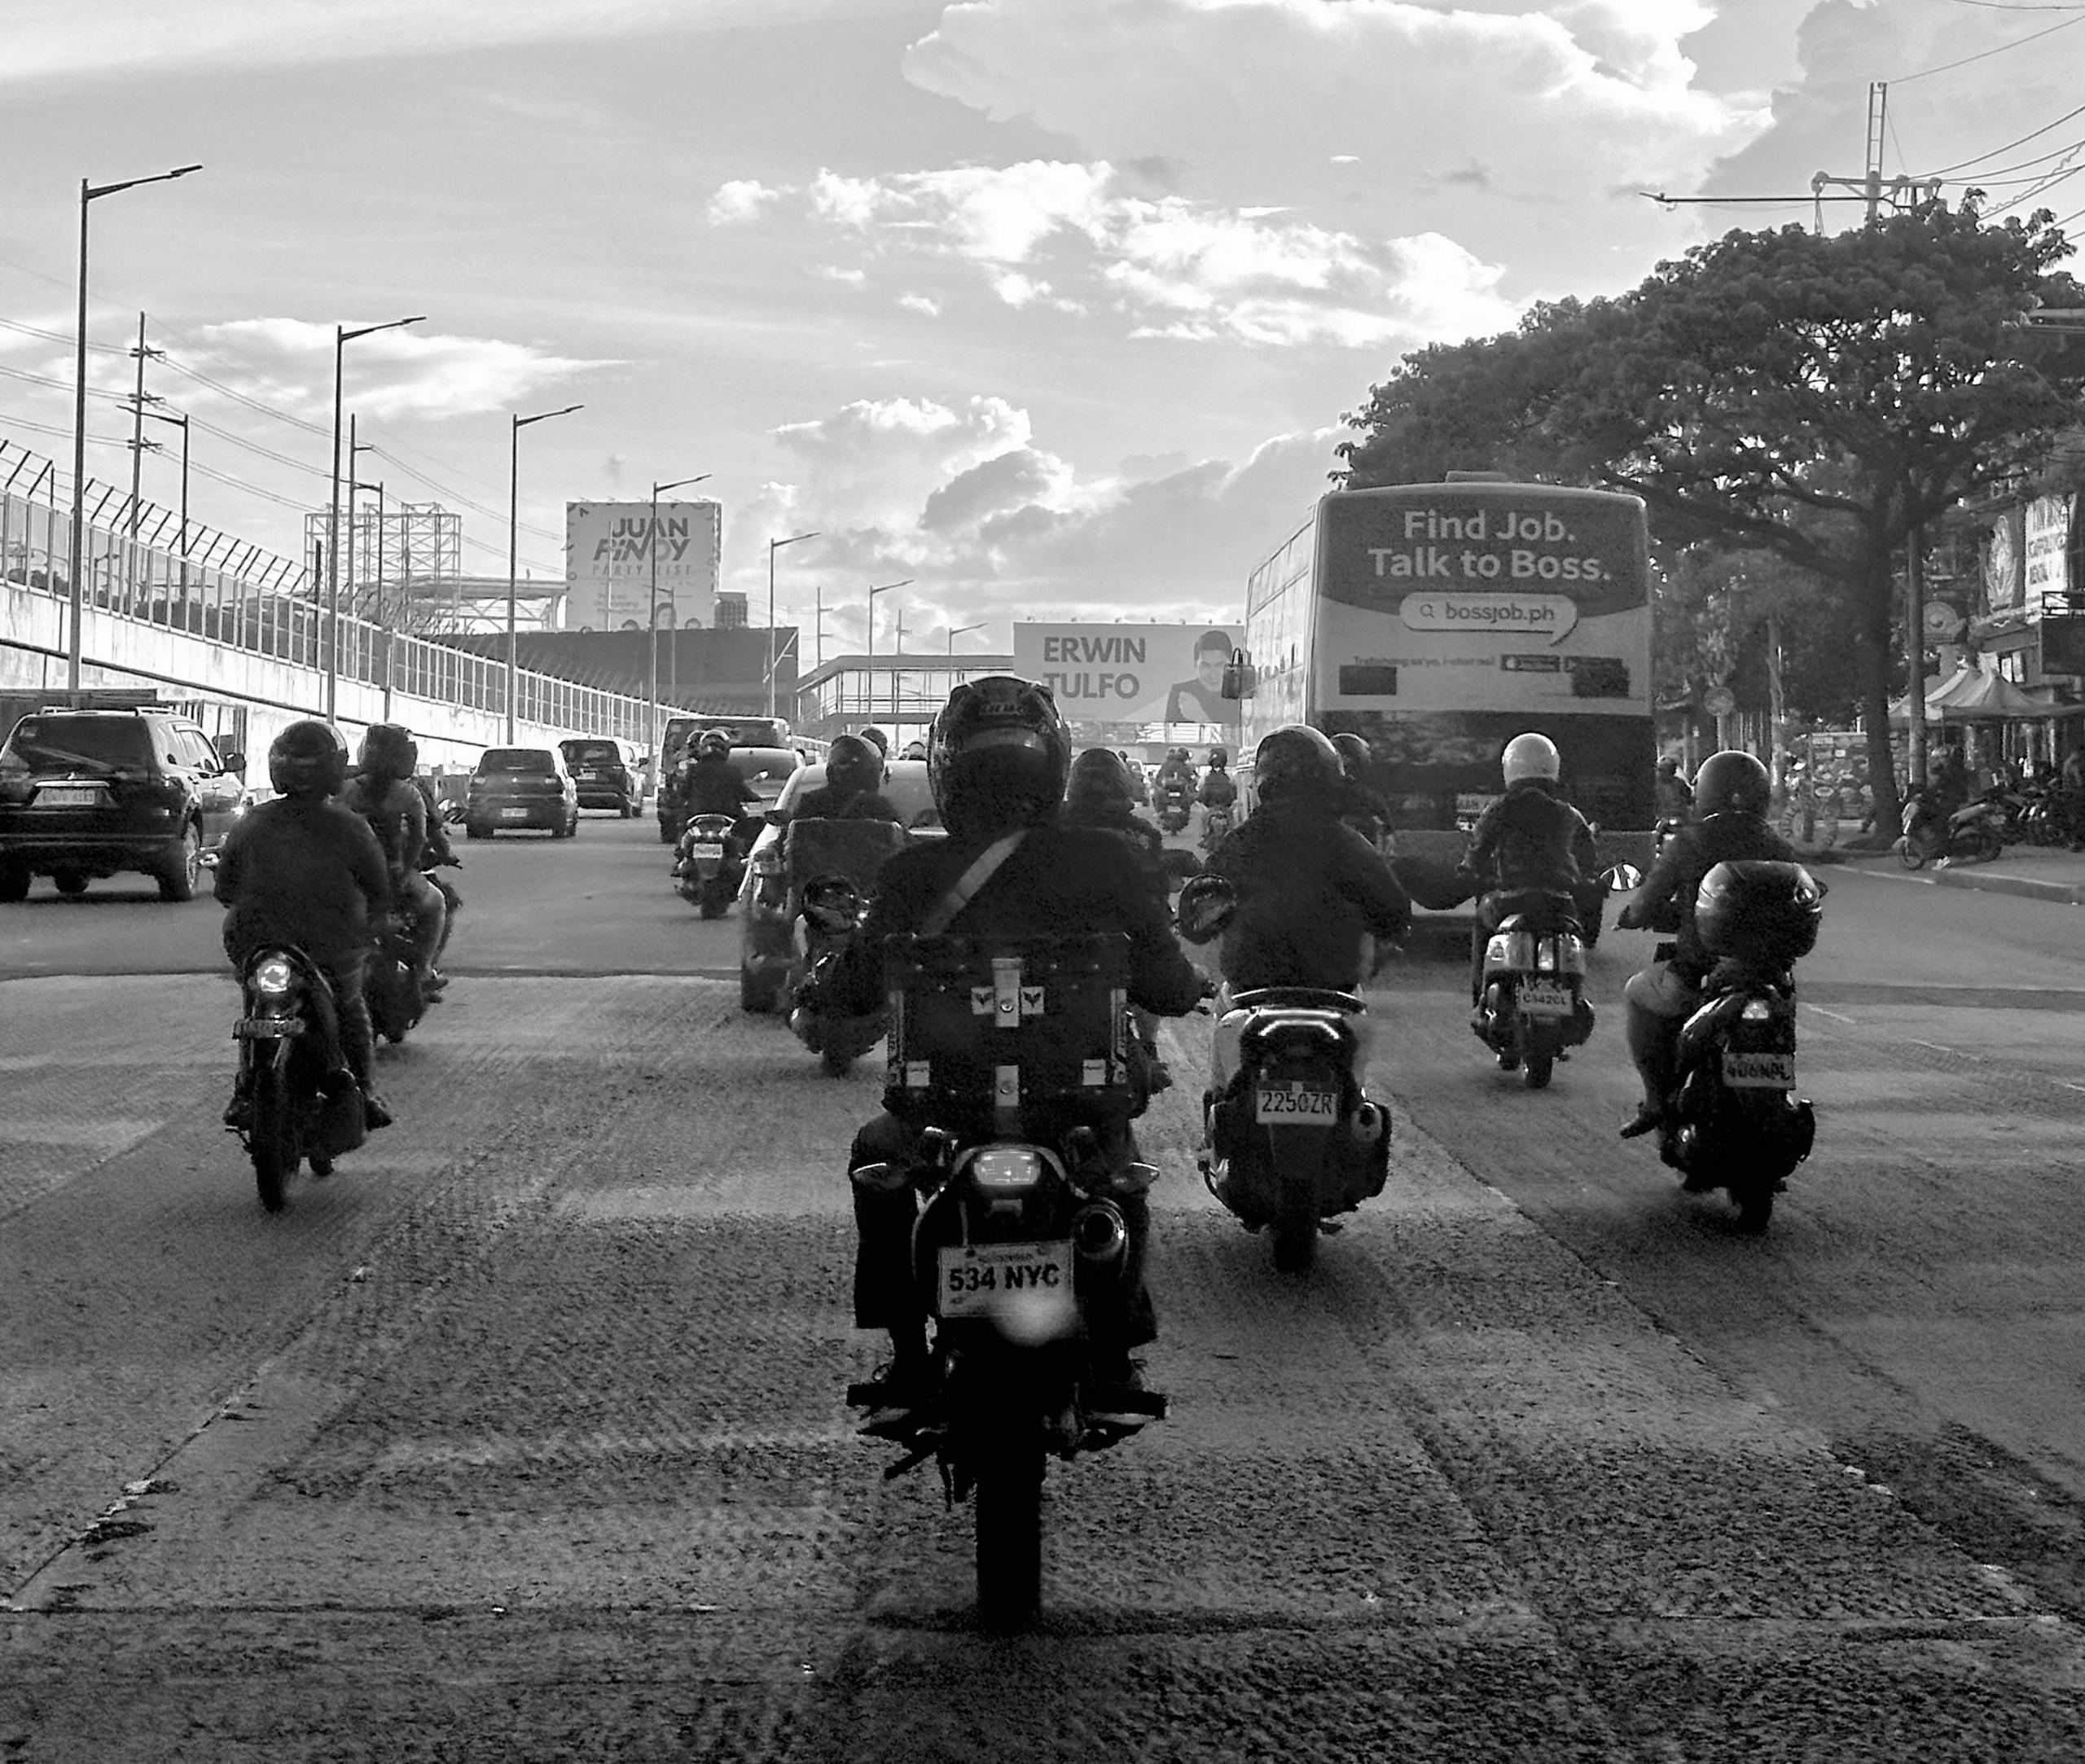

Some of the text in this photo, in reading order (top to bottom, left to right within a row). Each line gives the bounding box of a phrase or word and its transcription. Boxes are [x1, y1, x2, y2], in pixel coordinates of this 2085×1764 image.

[612, 518, 689, 538] JUAN
[1404, 509, 1576, 542] Find Job.
[1367, 546, 1611, 580] Talk to Boss.
[1446, 602, 1555, 624] bossjob.ph
[1043, 637, 1146, 663] ERWIN
[1042, 673, 1140, 699] TULFO
[949, 1263, 1060, 1292] 534 NYC
